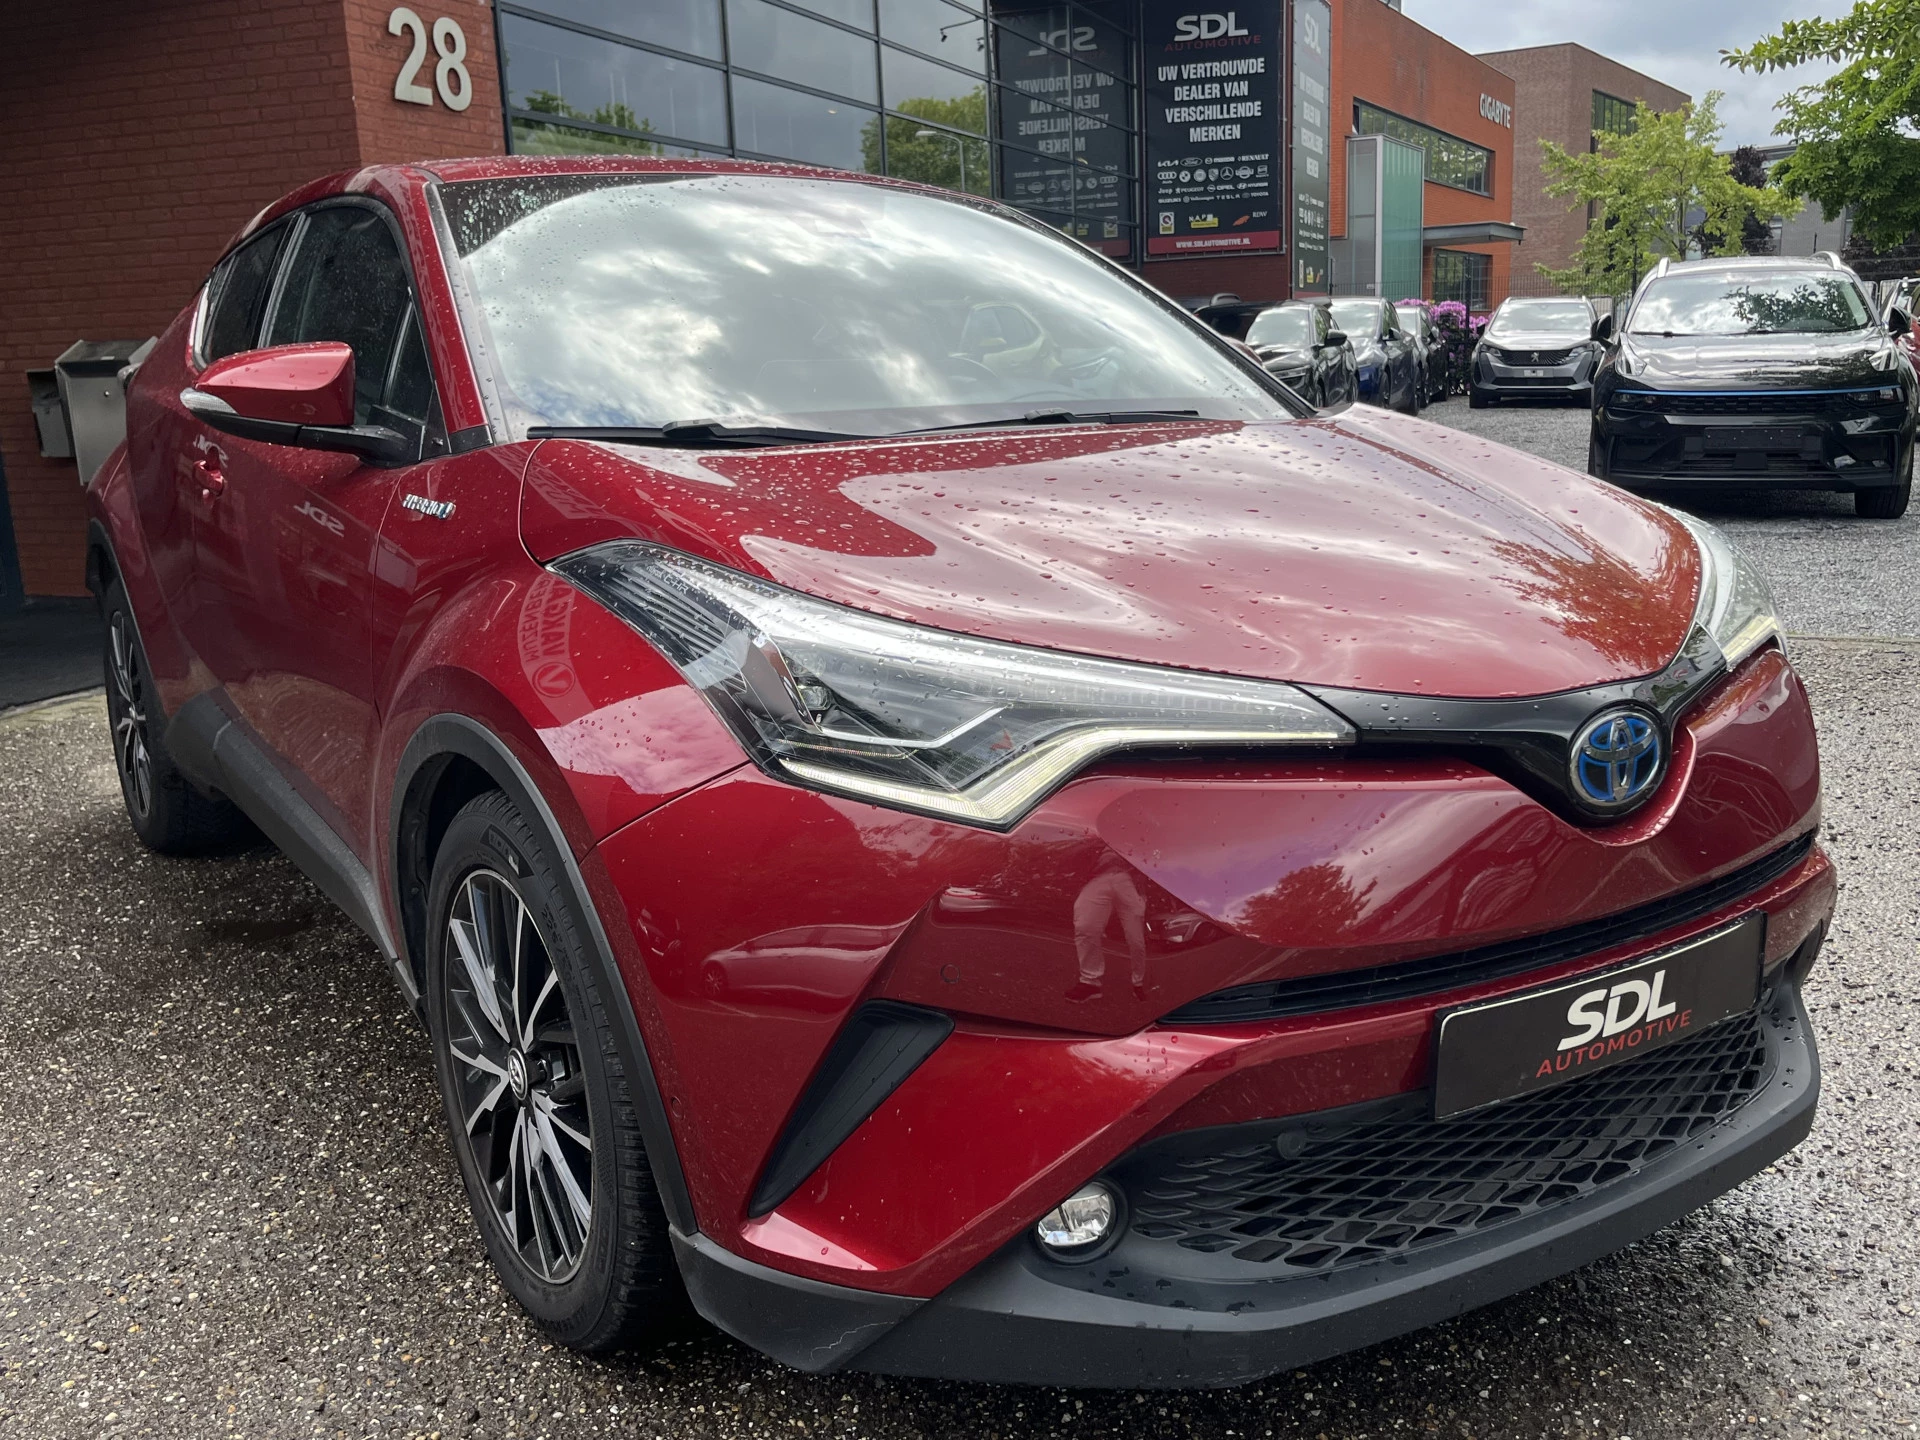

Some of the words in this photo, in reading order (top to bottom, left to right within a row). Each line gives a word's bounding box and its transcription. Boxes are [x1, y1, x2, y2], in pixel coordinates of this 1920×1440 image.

[1173, 12, 1249, 42] SDL
[1164, 34, 1263, 52] AUTOMOTIVE
[388, 6, 473, 112] 28
[1157, 66, 1178, 82] UW
[1181, 57, 1265, 79] VERTROUWDE
[1174, 83, 1221, 102] DEALER
[1223, 81, 1249, 98] VAN
[1165, 101, 1262, 124] VERSCHILLENDE
[1480, 92, 1511, 129] GIGABYTE
[1189, 123, 1241, 143] MERKEN
[1557, 969, 1677, 1052] SDL
[1535, 1009, 1693, 1079] AUTOMOTIVE
